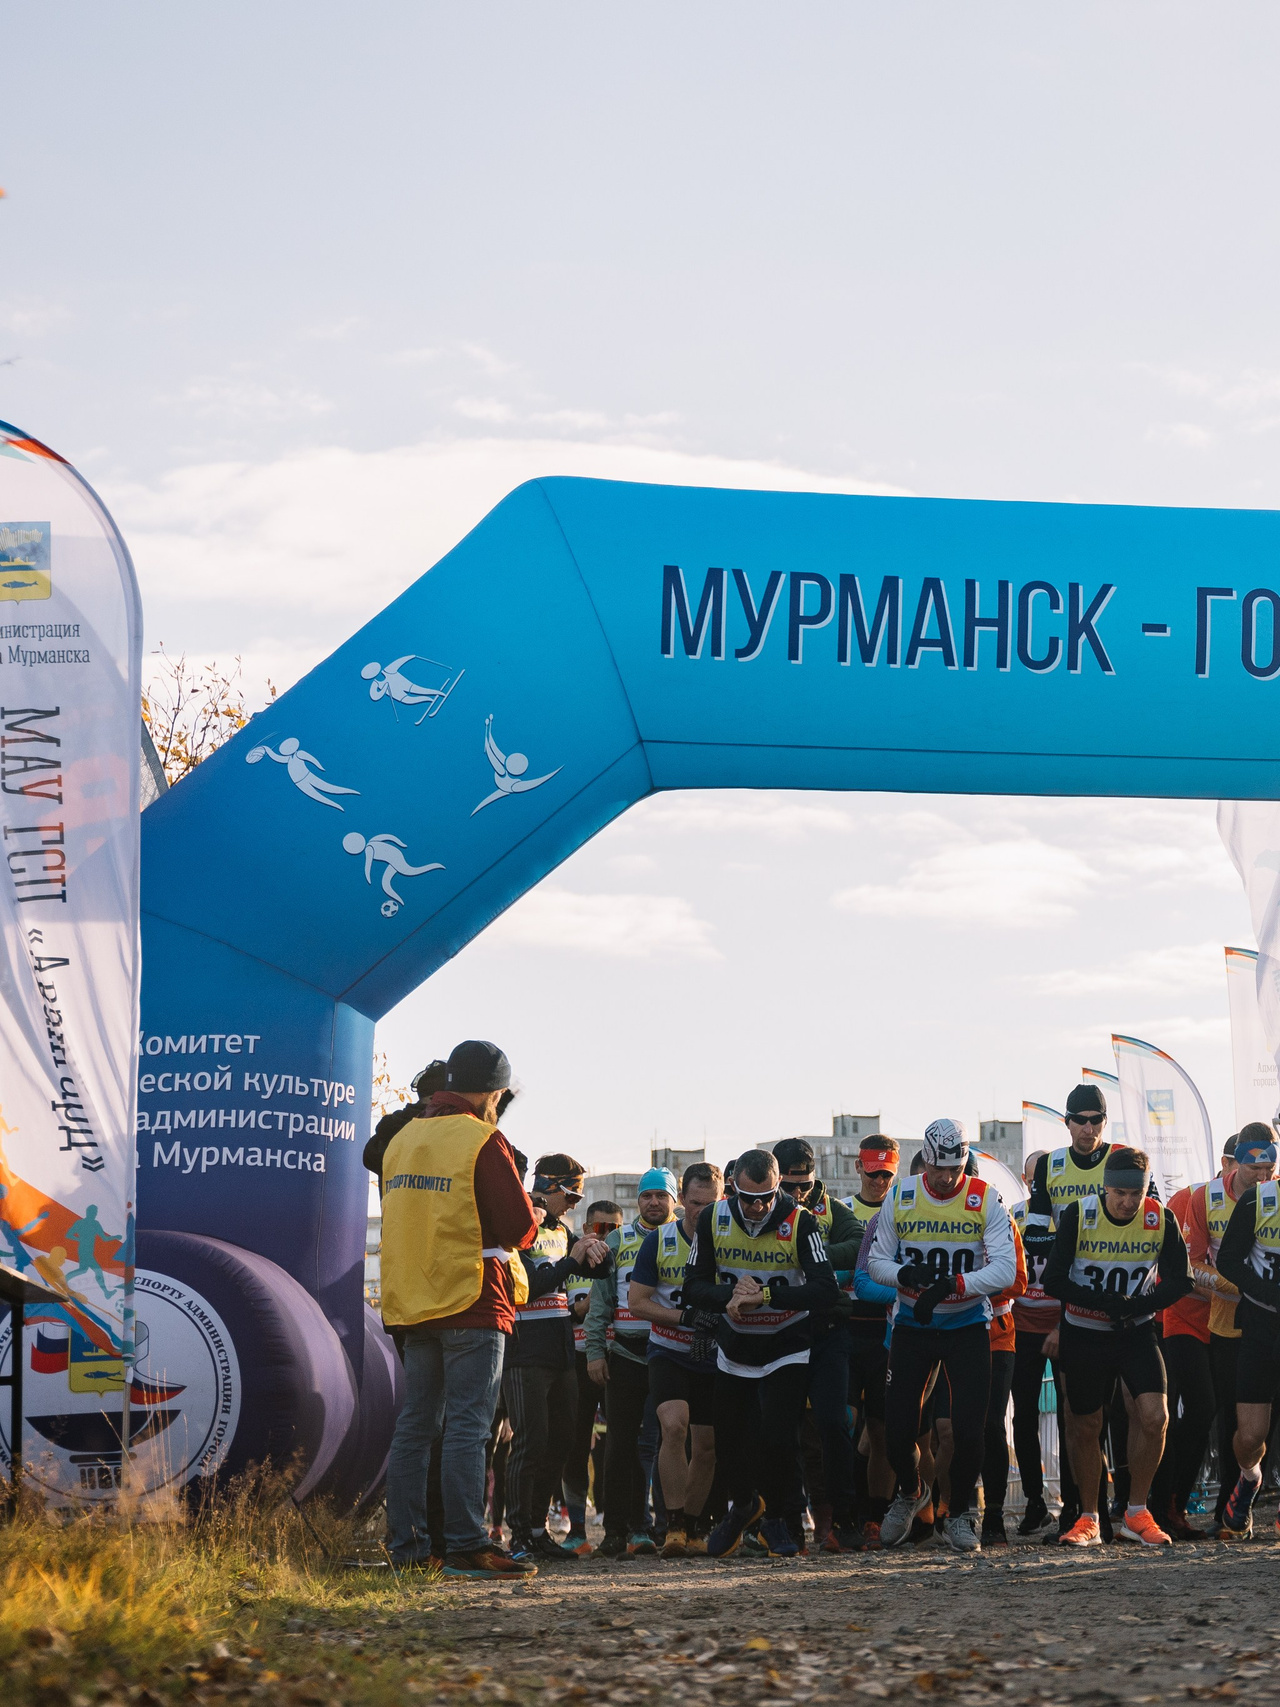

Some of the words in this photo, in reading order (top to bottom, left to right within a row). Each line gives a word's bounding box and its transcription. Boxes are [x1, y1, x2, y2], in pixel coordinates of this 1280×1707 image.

[660, 564, 1117, 676] МУРМАНСК
[8, 645, 90, 667] Мурманска
[0, 706, 63, 804] МАУ
[243, 1071, 356, 1108] культуре
[136, 1109, 356, 1142] администрации
[152, 1141, 326, 1174] Мурманска
[1050, 1184, 1105, 1198] МУРМАН
[896, 1220, 982, 1235] МУРМАНСК
[713, 1247, 795, 1264] МУРМАНСК
[1078, 1240, 1161, 1254] МУРМАНСК
[134, 1276, 186, 1300] СПОРТУ
[184, 1299, 233, 1415] АДМИНИСТРАЦИИ
